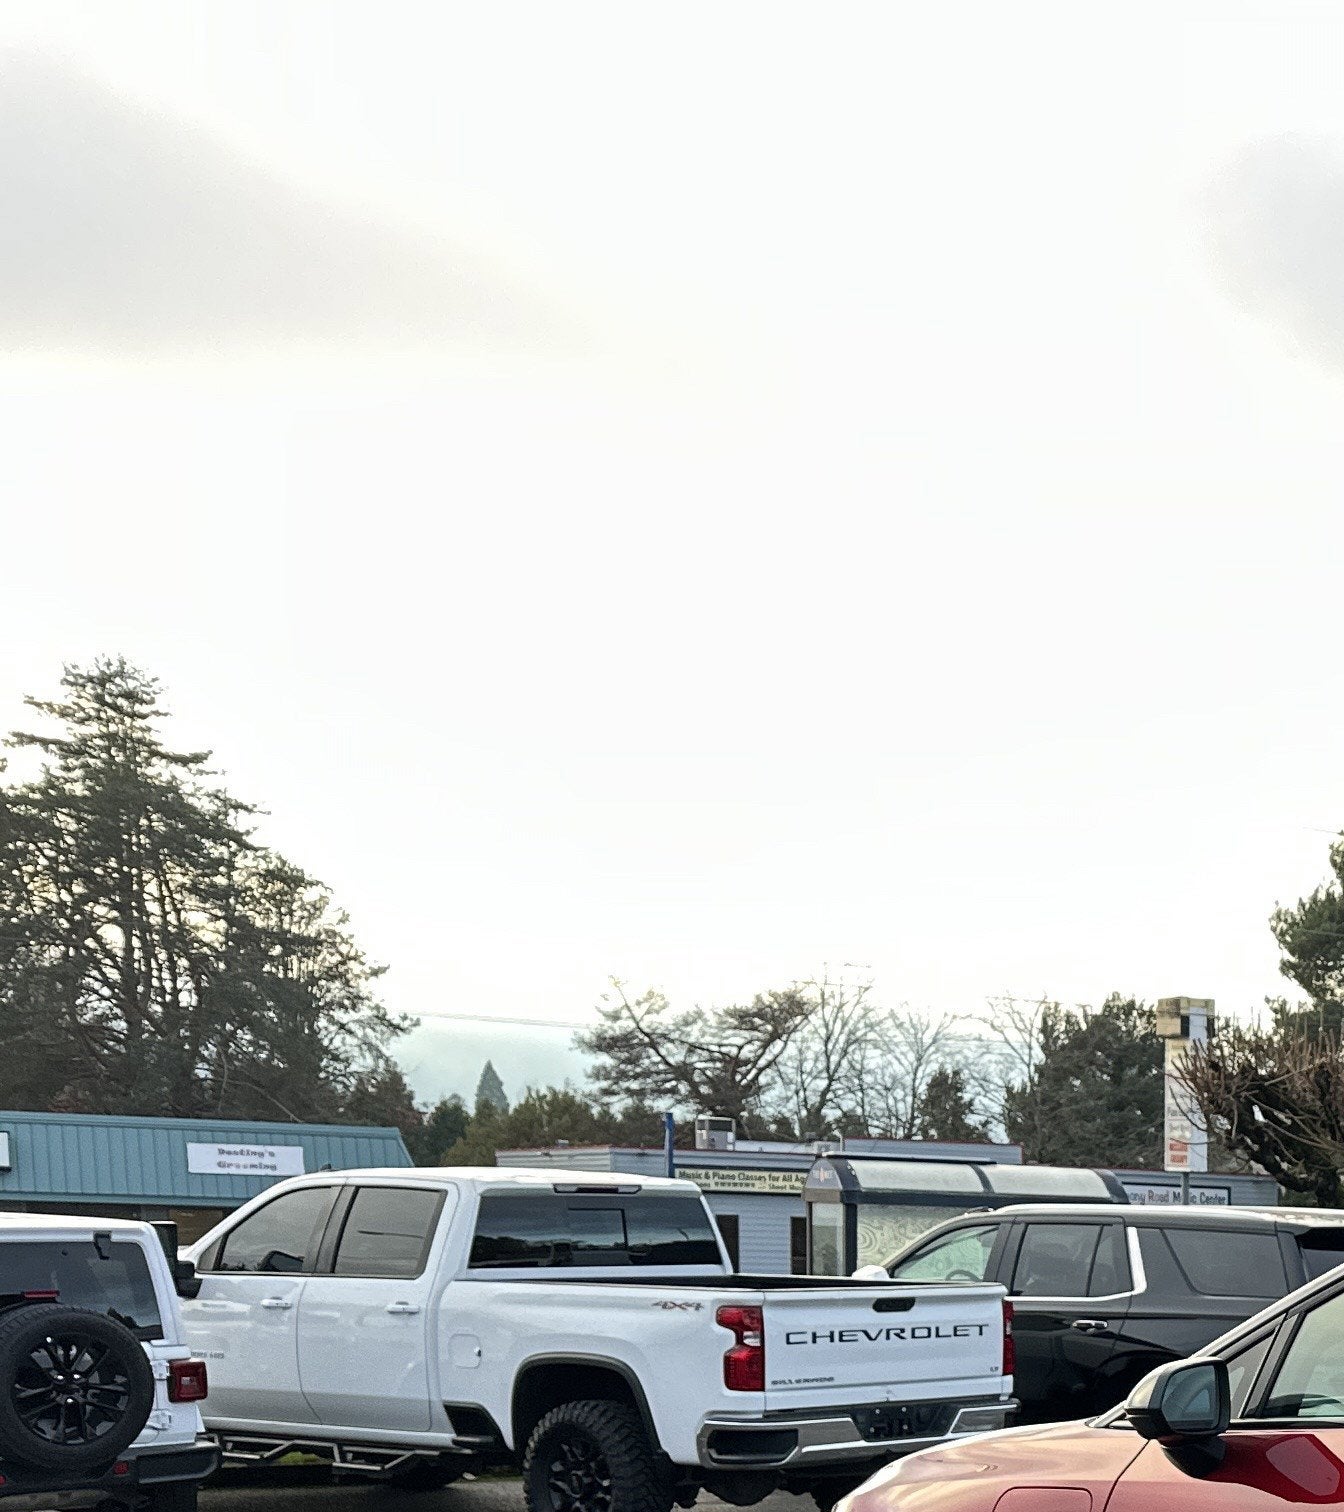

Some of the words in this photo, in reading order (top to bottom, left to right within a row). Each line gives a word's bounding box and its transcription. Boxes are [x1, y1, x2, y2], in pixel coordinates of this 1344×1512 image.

[678, 1170, 702, 1179] Music
[712, 1172, 737, 1181] Piano
[738, 1173, 766, 1182] Classes
[768, 1173, 780, 1182] for
[782, 1174, 792, 1182] All
[785, 1323, 990, 1345] CHEVROLET
